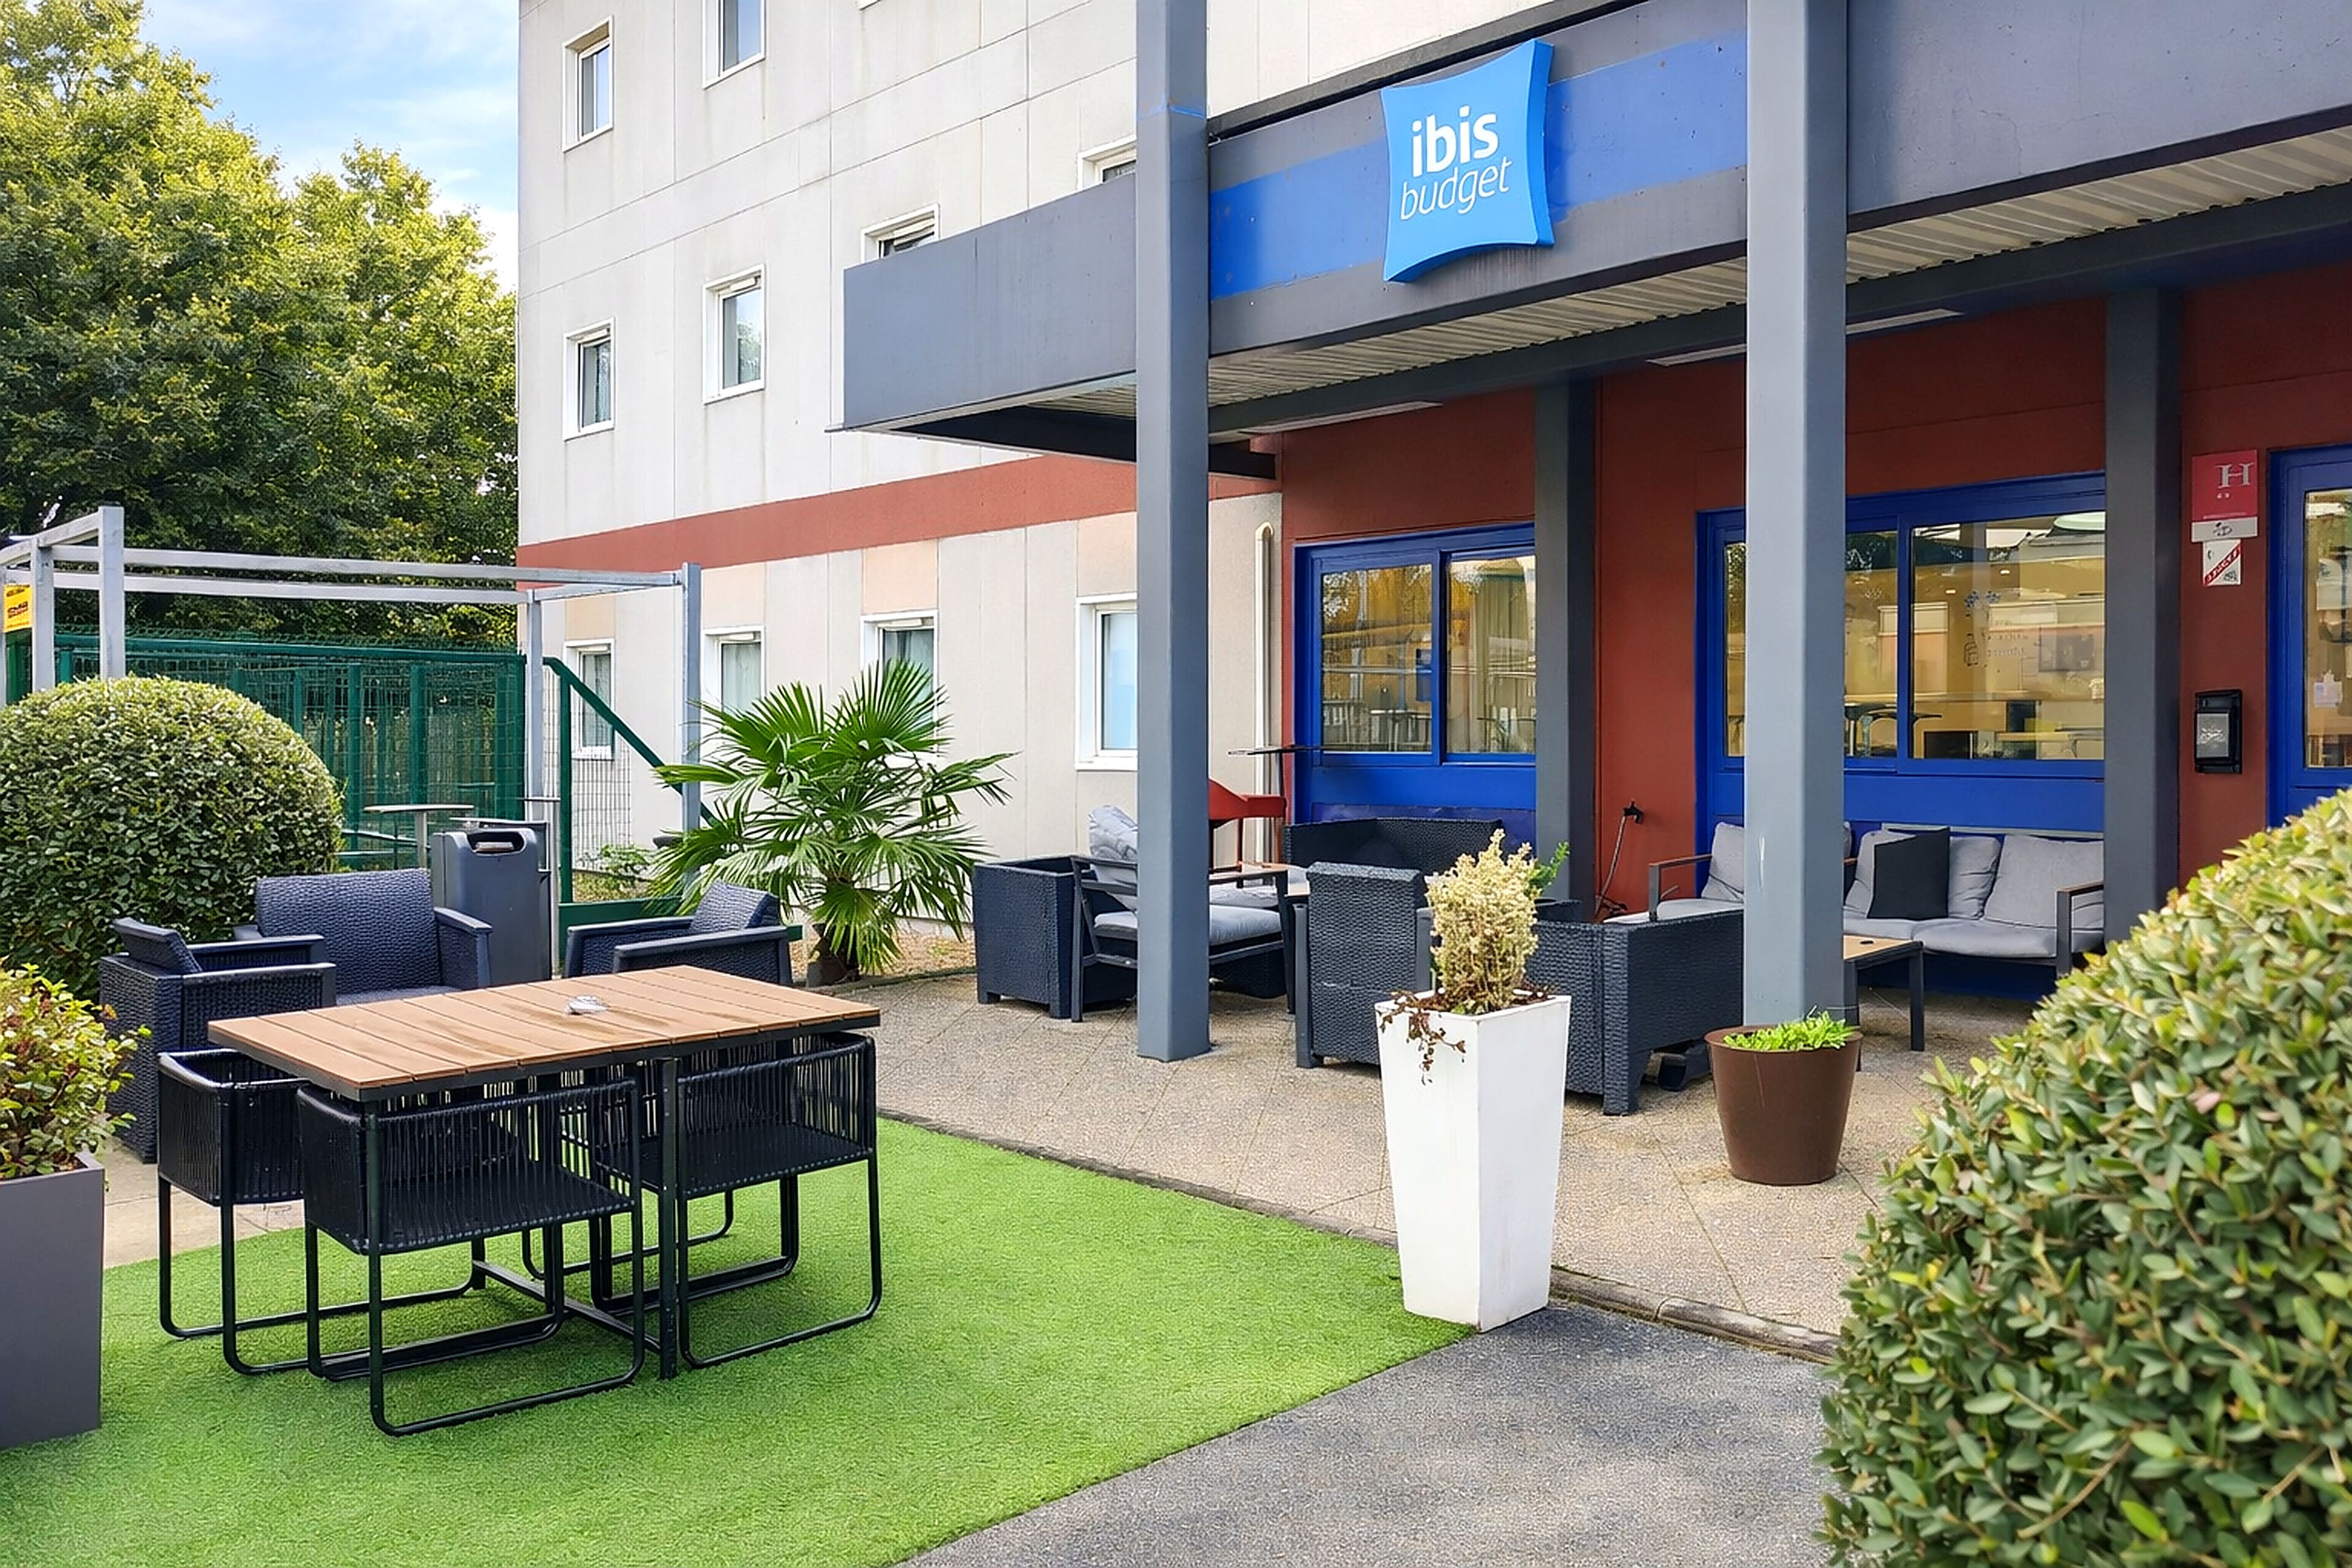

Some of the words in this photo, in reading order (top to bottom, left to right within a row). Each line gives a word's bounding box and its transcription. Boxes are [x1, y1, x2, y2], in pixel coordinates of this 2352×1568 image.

[1412, 105, 1499, 178] ibis
[1400, 157, 1512, 221] budget
[2217, 462, 2254, 489] H
